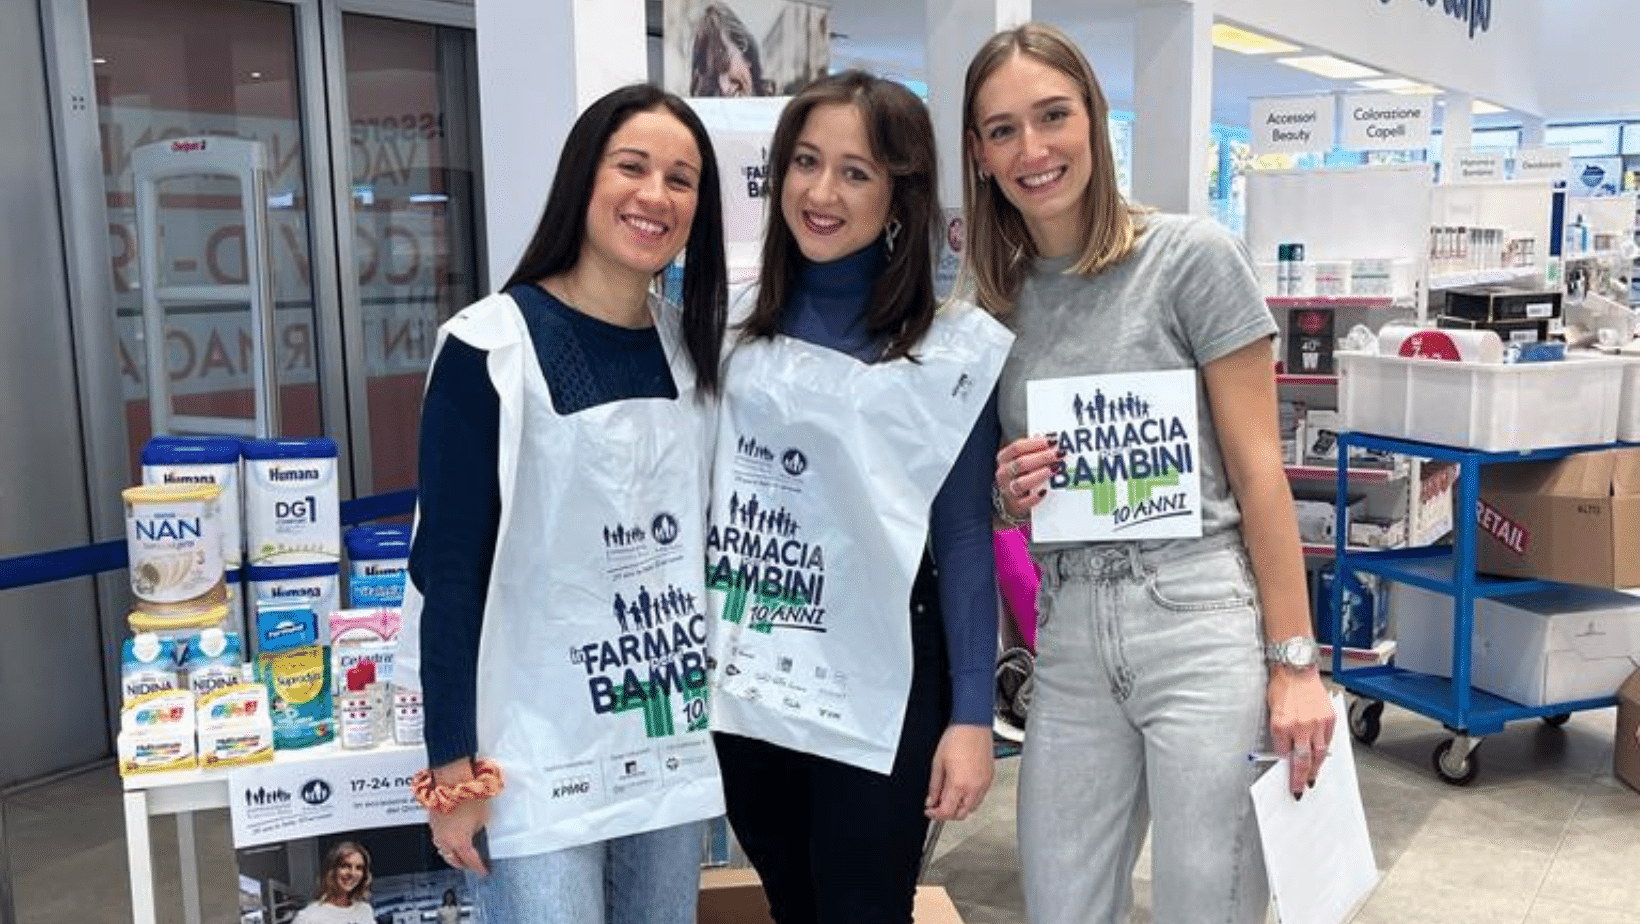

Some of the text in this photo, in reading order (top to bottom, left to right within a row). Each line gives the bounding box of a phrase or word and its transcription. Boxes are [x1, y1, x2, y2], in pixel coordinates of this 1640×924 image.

[1266, 111, 1316, 125] Accessori
[1353, 107, 1421, 121] Colorazione
[1272, 128, 1311, 143] Beauty
[1366, 124, 1405, 140] Capelli
[269, 467, 319, 481] Humana
[1050, 443, 1192, 489] BAMBINI
[164, 473, 215, 484] Humana
[1112, 493, 1187, 524] 10 ANNI
[135, 517, 201, 540] NAN
[1476, 498, 1524, 553] RETAIL
[707, 525, 824, 571] ARMACIA
[705, 553, 824, 605] AMBINI
[271, 586, 321, 597] Humana
[751, 606, 825, 624] 10 ANNI
[583, 613, 707, 674] FARMAC
[589, 647, 707, 714] BAMB
[350, 777, 413, 792] 17-24 no
[552, 781, 589, 799] KPMG
